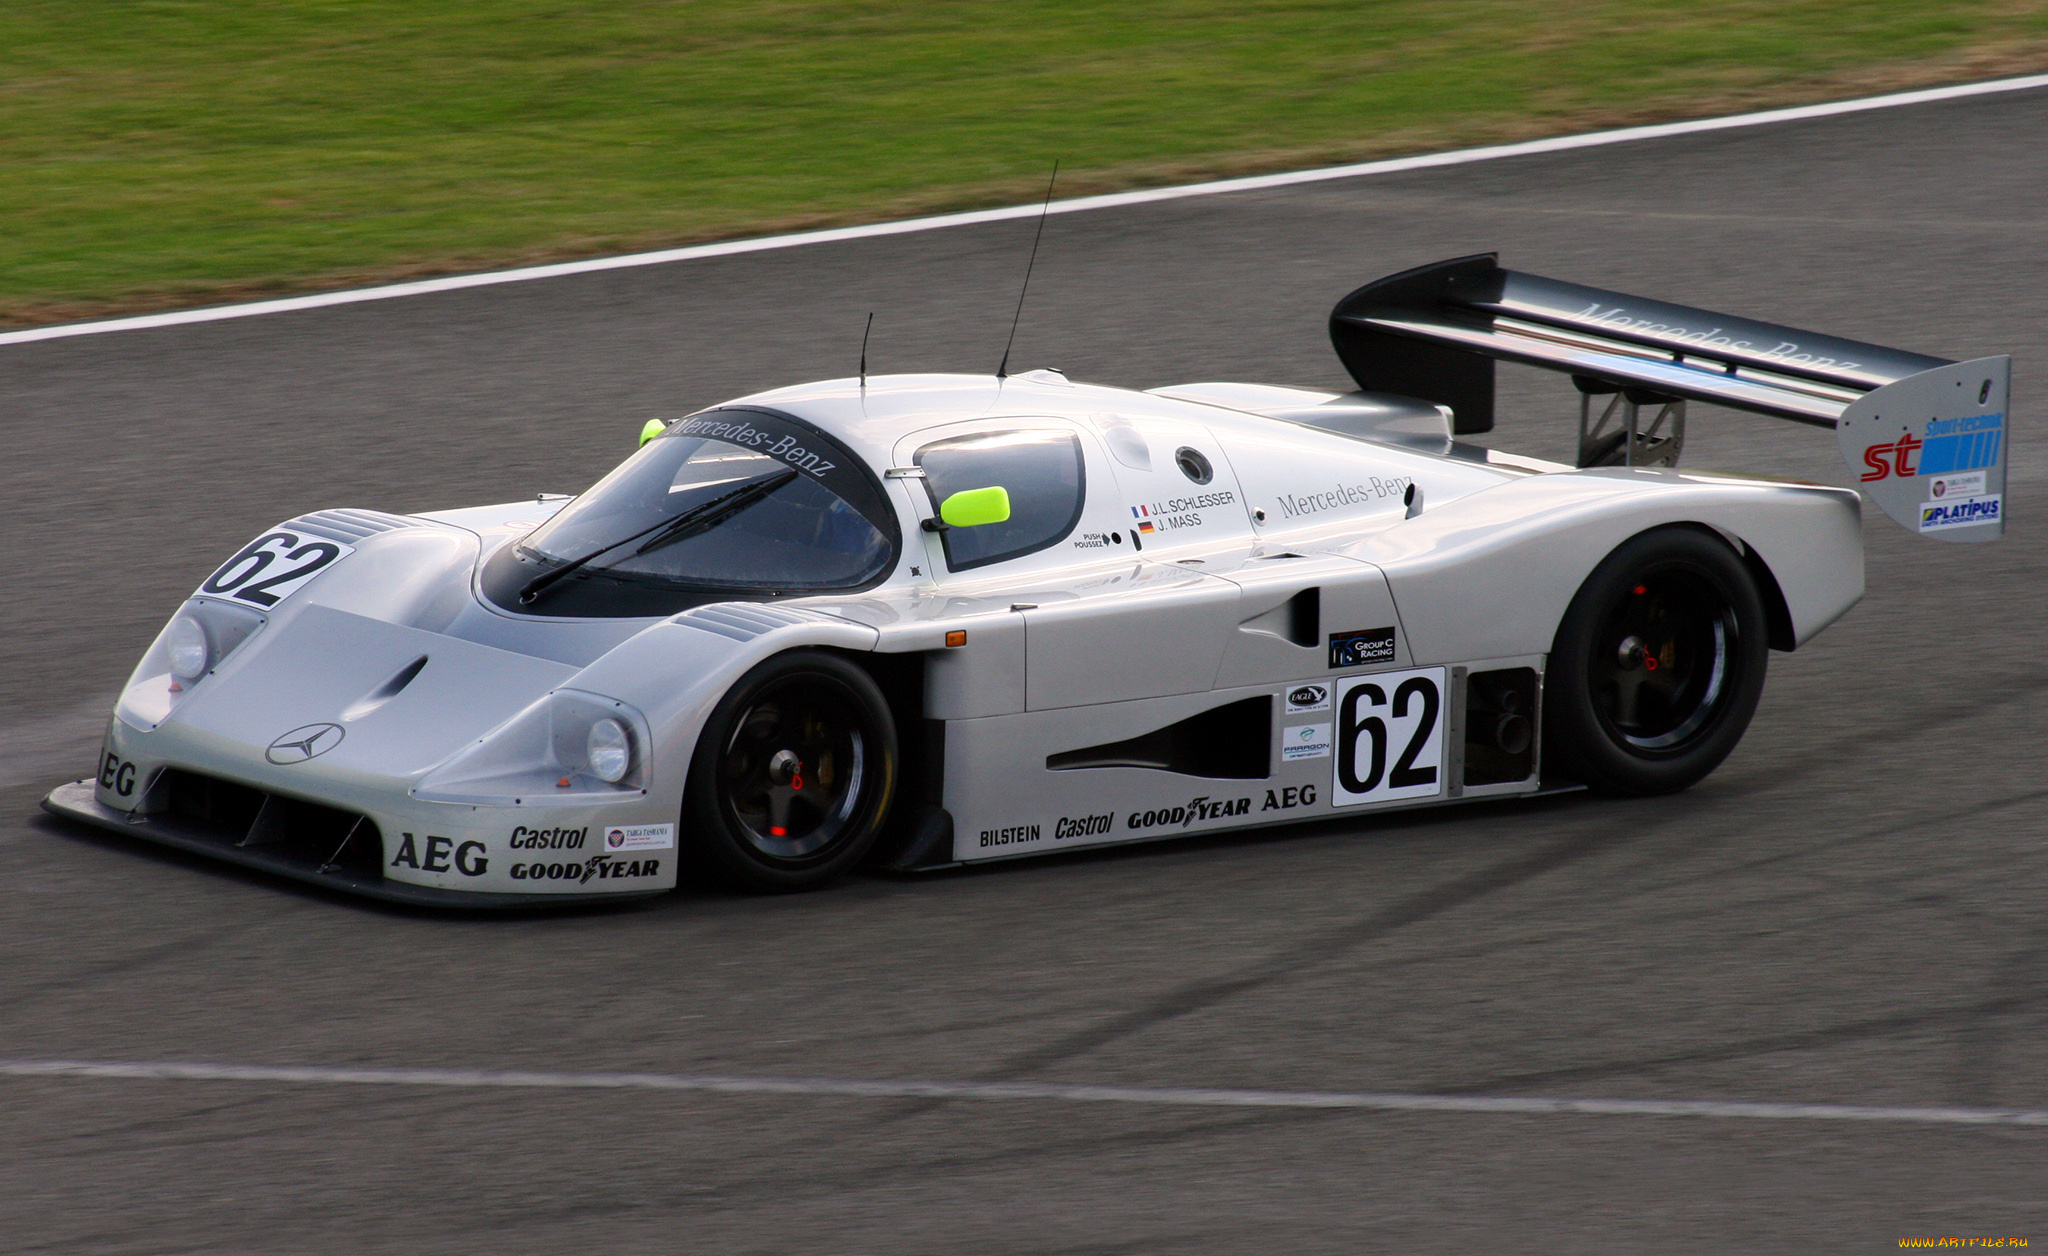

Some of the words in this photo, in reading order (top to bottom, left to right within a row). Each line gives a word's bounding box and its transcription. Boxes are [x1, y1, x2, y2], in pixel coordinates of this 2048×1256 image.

[665, 417, 836, 478] Mercedes-Benz
[1169, 513, 1202, 530] MASS
[1074, 540, 1103, 548] POUSSEZ
[202, 532, 340, 607] 62
[1355, 641, 1384, 650] GROUP
[1385, 638, 1393, 647] C
[1360, 648, 1393, 658] RACING
[1291, 692, 1312, 701] EAGLE
[1337, 677, 1440, 794] 62
[1284, 743, 1330, 752] PARAGON
[1261, 784, 1316, 811] AEG
[980, 825, 1040, 847] BILSTEIN
[1055, 812, 1114, 839] Castrol
[510, 826, 588, 849] Castrol
[391, 832, 488, 876] AEG
